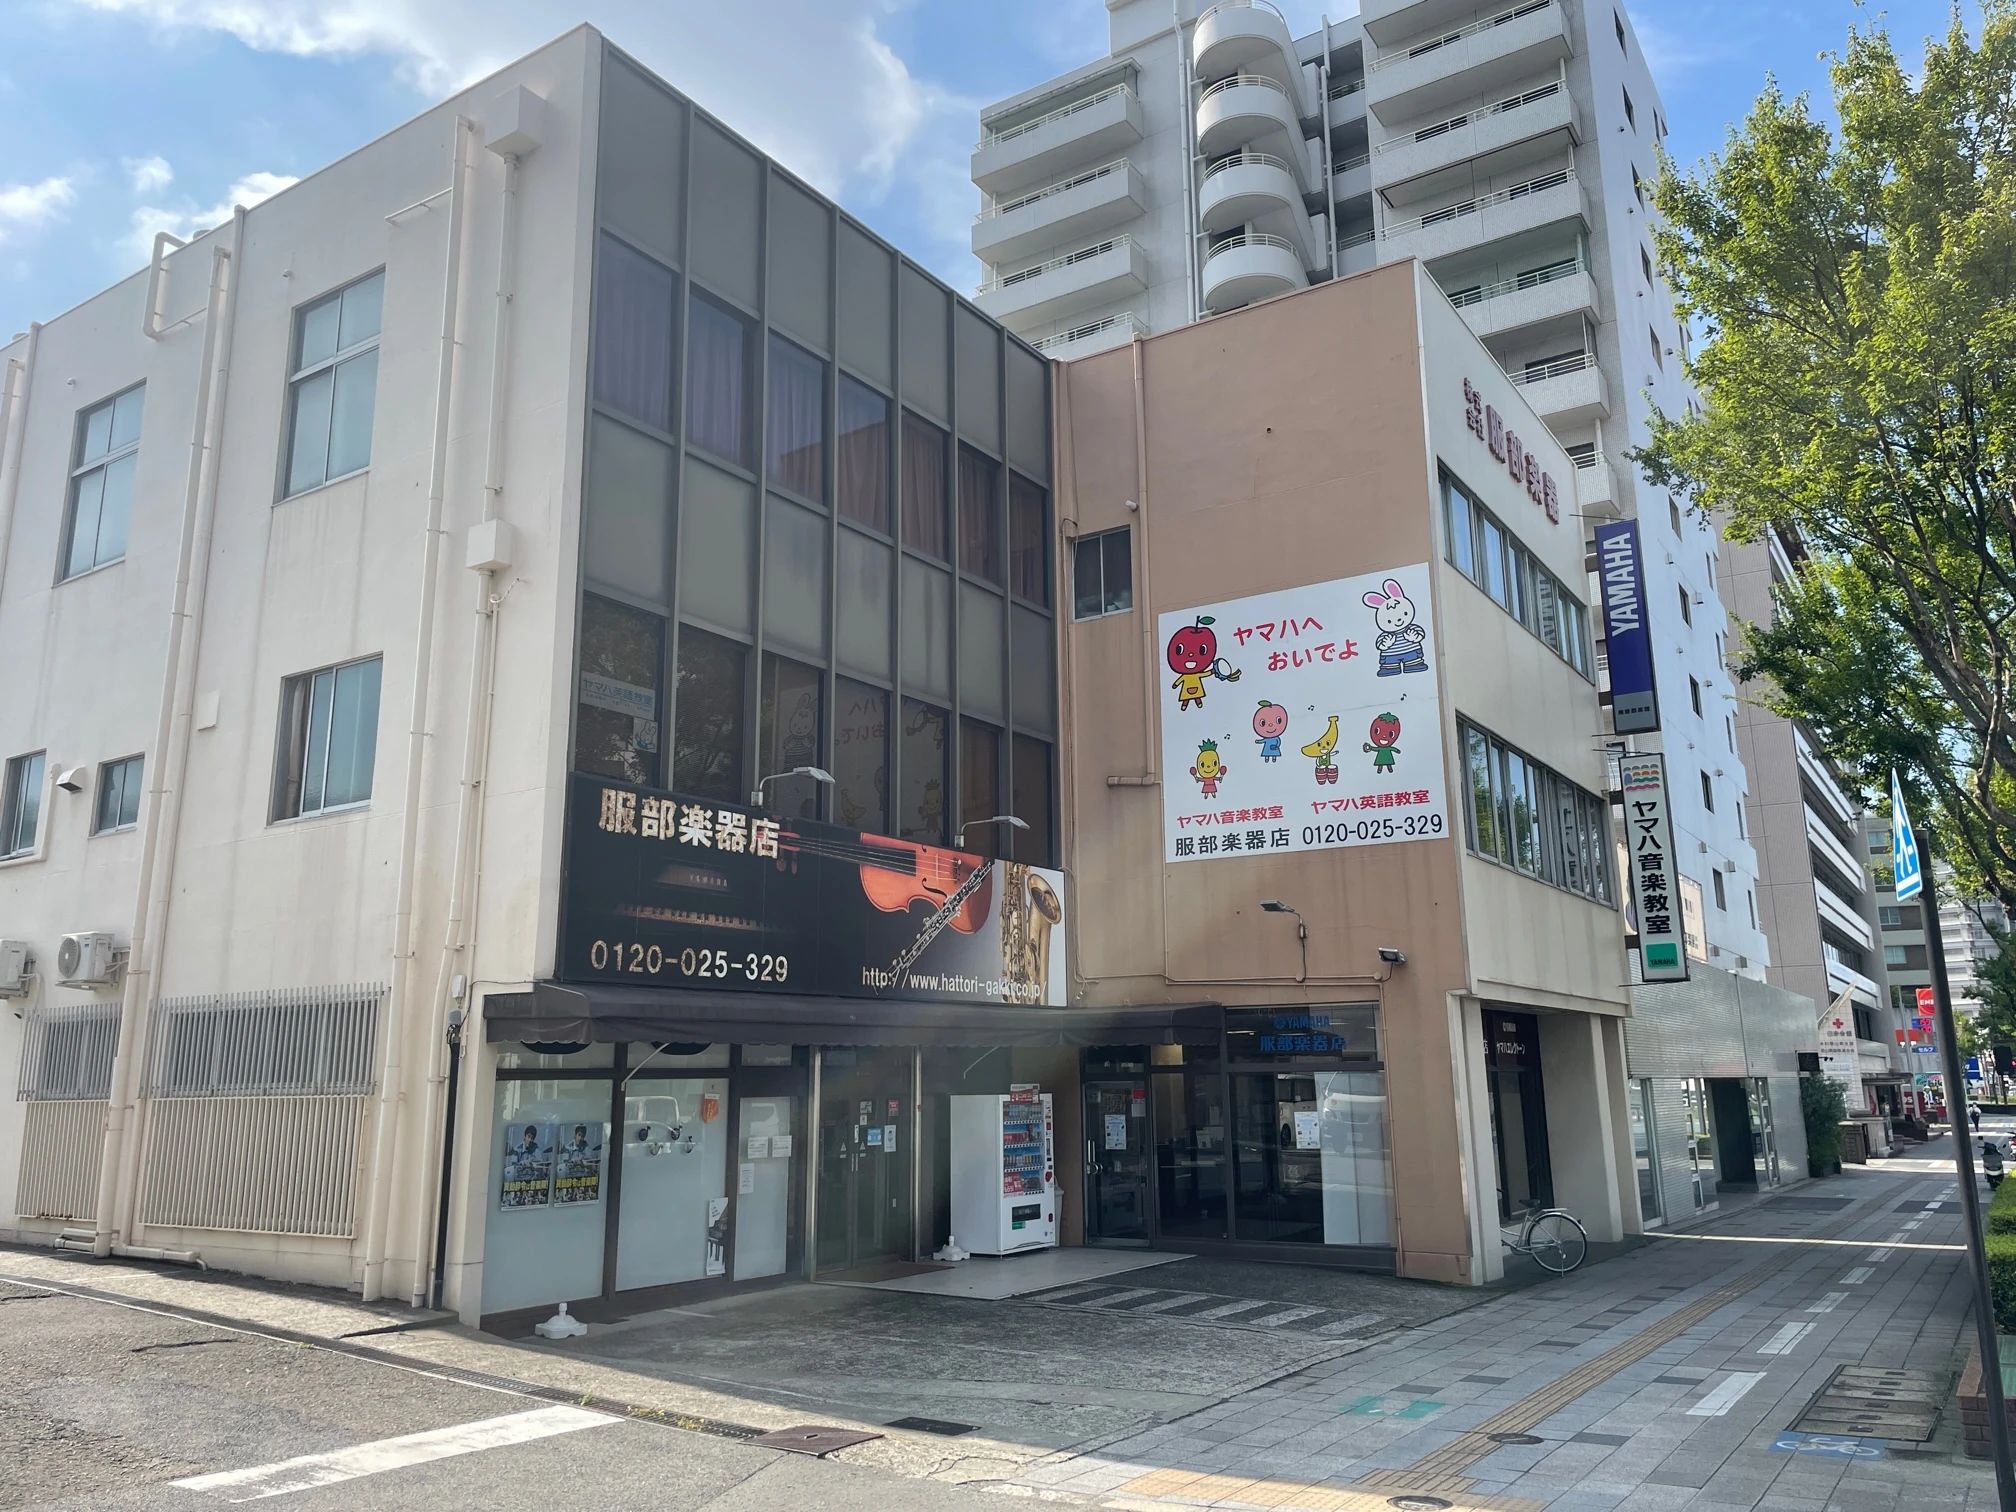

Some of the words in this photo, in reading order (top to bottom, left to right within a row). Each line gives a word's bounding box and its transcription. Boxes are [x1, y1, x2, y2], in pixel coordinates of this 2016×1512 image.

[1603, 532, 1640, 637] YAMAHA
[1233, 616, 1323, 646] ヤマハへ
[1267, 639, 1359, 672] おいでよ
[599, 788, 781, 859] 服部楽器店
[1177, 806, 1284, 828] ヤマハ音楽教室
[1311, 790, 1431, 814] ヤマハ英語教室
[1175, 828, 1291, 857] 服部楽器店
[1302, 813, 1443, 845] 0120-025-329
[1632, 800, 1672, 934] ヤマハ音楽教室
[591, 940, 788, 983] 0120-025-329
[862, 966, 1047, 999] http://www.hattori-gakki.co.jp/
[1288, 1015, 1330, 1030] YAMAHA
[1260, 1034, 1346, 1051] 服部楽器店
